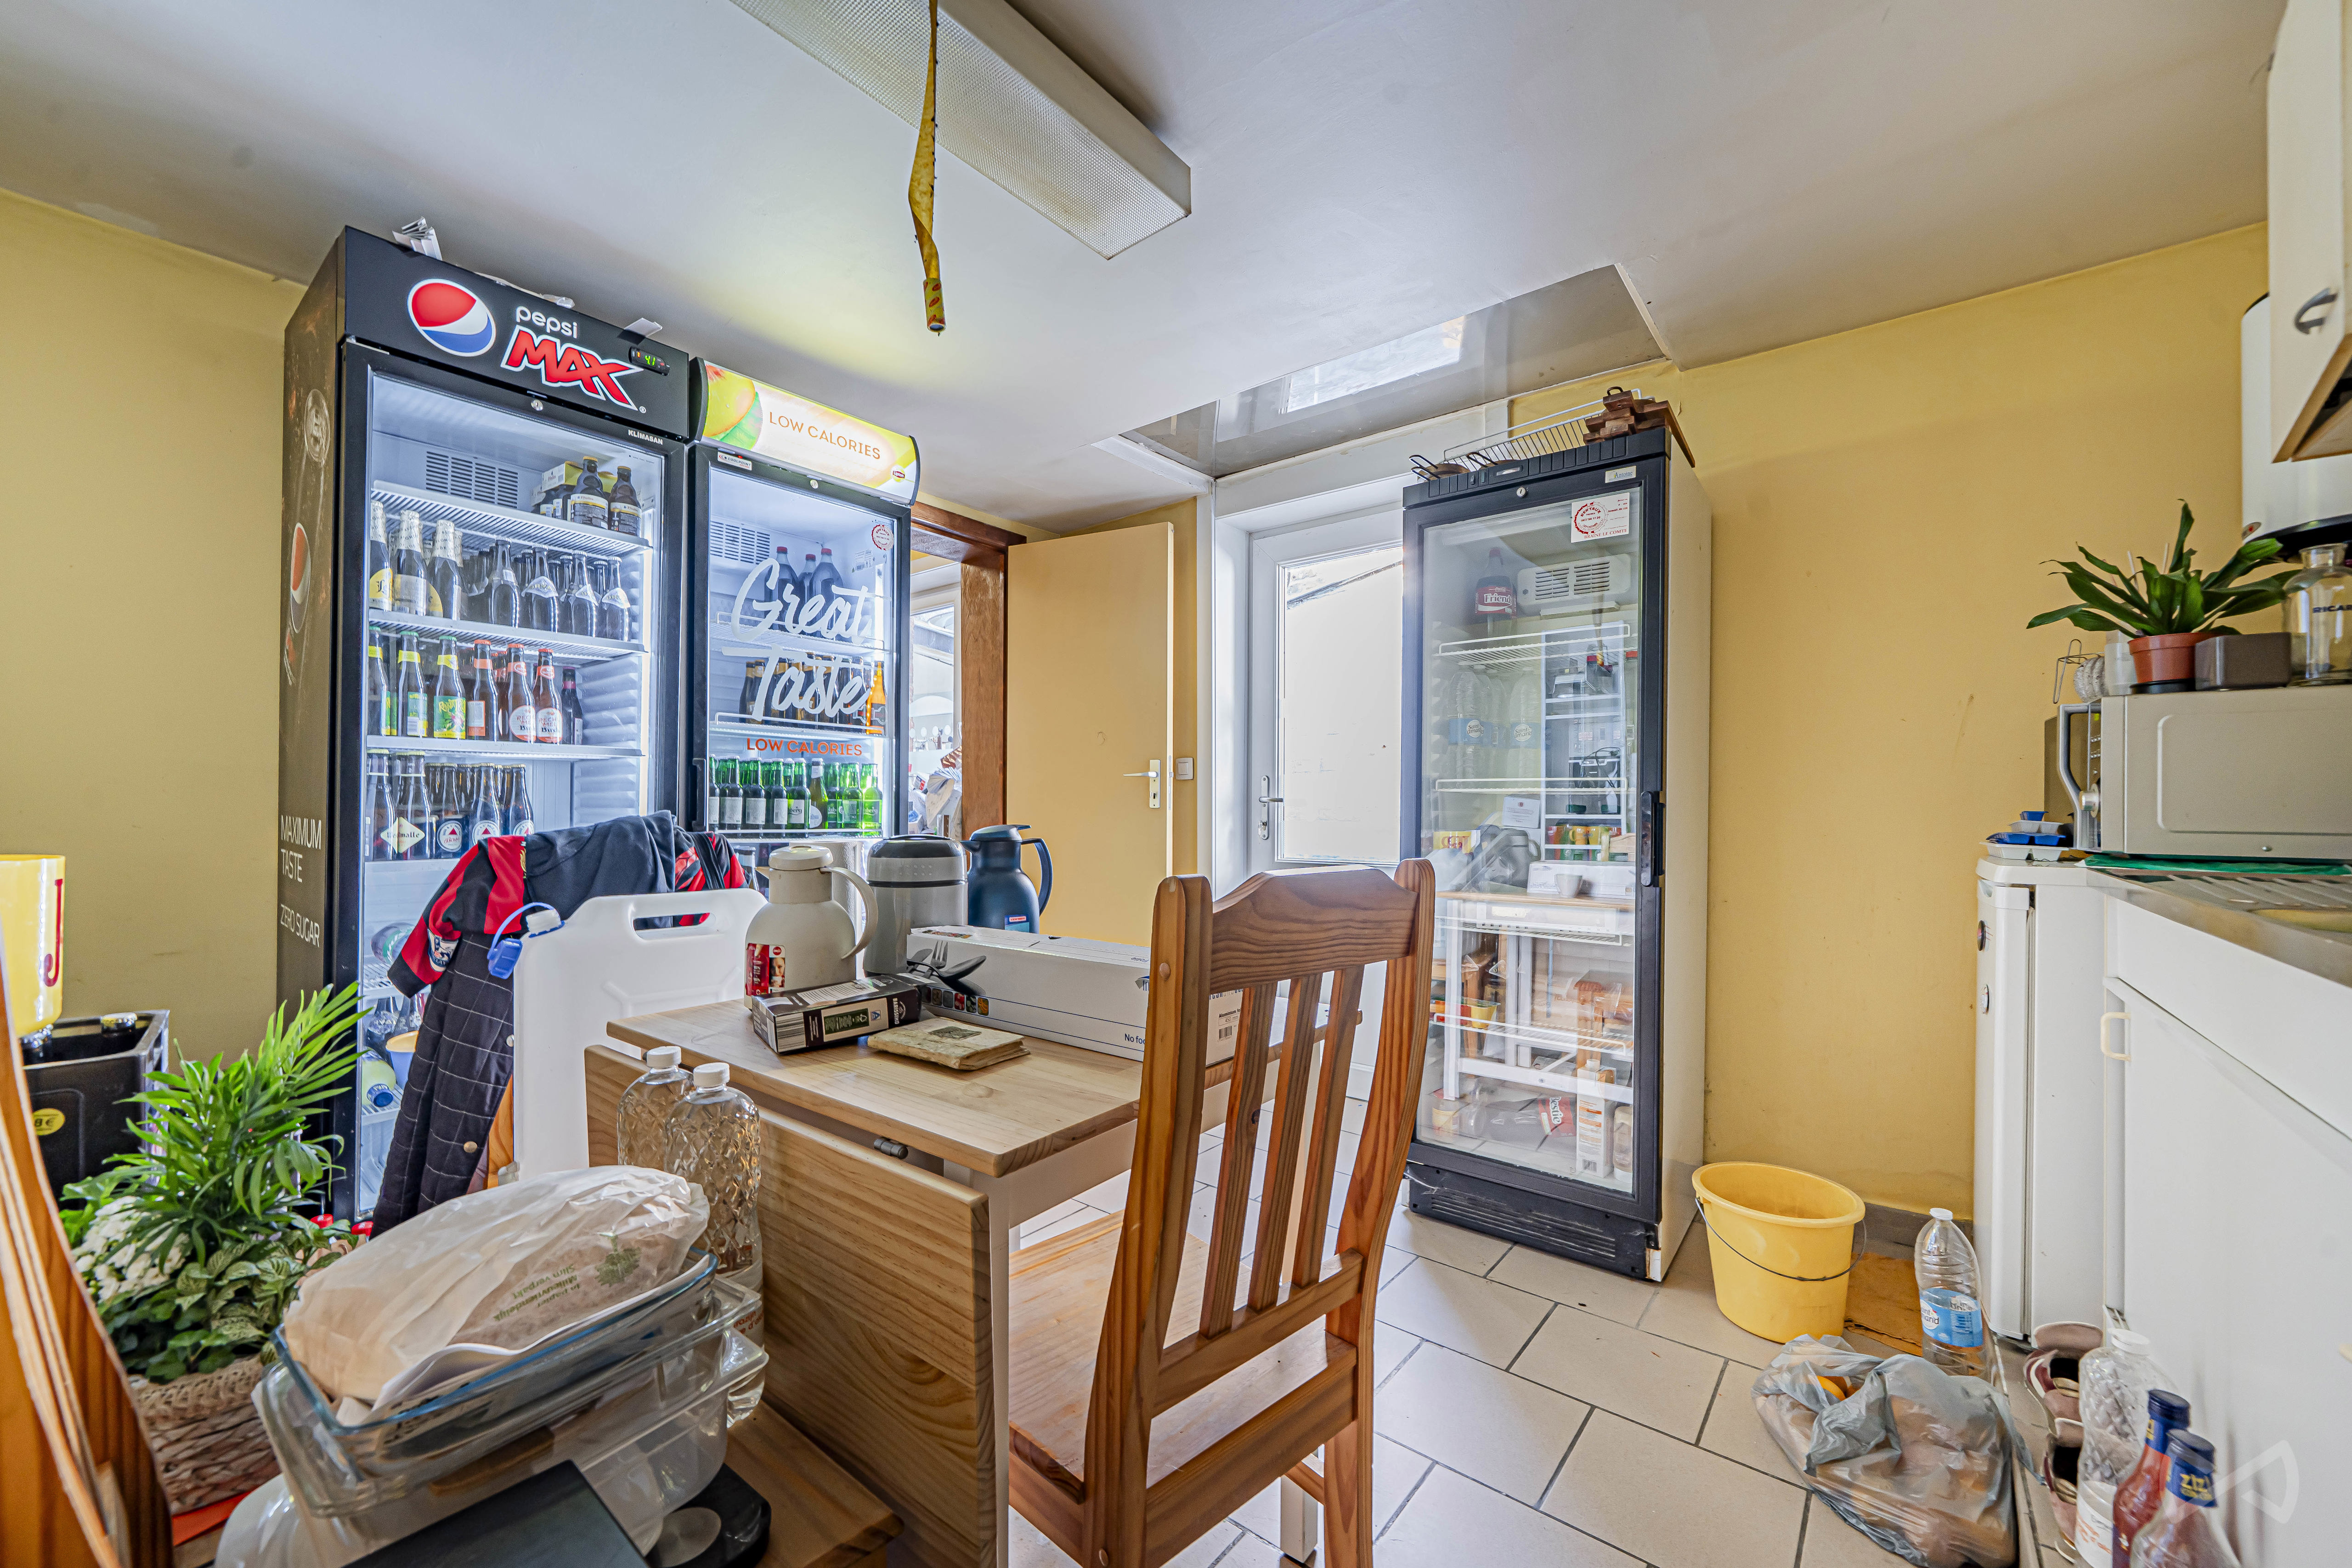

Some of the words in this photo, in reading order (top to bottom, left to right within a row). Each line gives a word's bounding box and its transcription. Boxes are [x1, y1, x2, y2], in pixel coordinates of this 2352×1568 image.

[515, 306, 577, 339] pepsi
[500, 324, 644, 411] MAX
[769, 411, 804, 433] LOW
[808, 425, 881, 459] CALORIES
[1580, 507, 1602, 517] BERTAUX
[731, 557, 872, 645] Great
[2312, 604, 2352, 613] RICAR
[722, 644, 877, 722] Taste
[747, 737, 784, 752] LOW
[787, 740, 863, 756] CALORIES
[281, 815, 322, 850] MAXIMUM
[281, 849, 303, 883] TASTE
[281, 904, 295, 933] ZERO
[296, 912, 320, 948] SUGAR
[1125, 1033, 1135, 1043] No
[1136, 1036, 1146, 1045] foo
